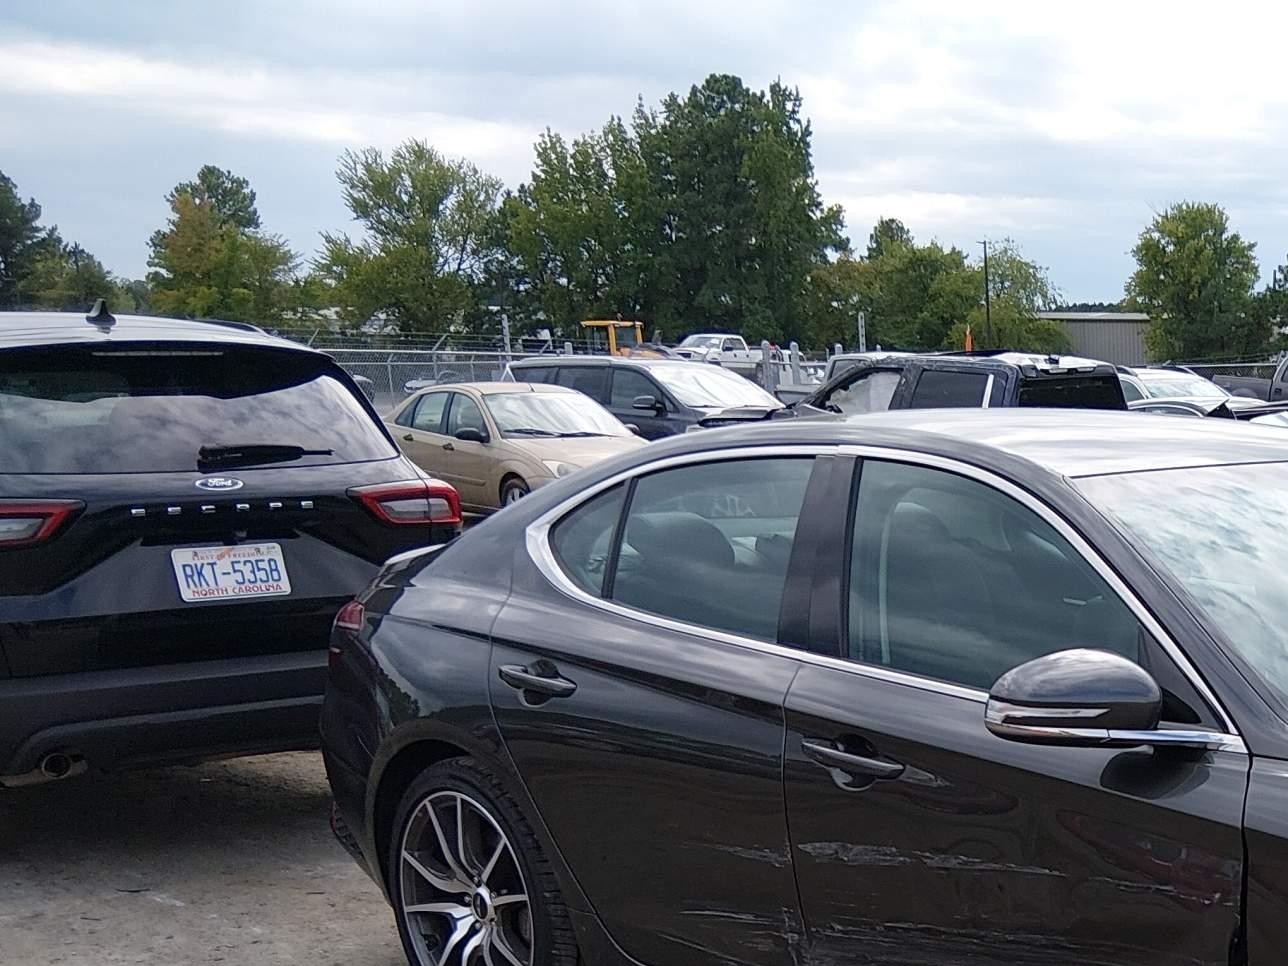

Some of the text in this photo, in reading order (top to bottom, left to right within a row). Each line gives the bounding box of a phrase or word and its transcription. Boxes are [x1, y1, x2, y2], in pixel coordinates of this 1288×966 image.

[181, 558, 282, 589] RKT-5358
[192, 583, 283, 598] NORTH CAROLINA
